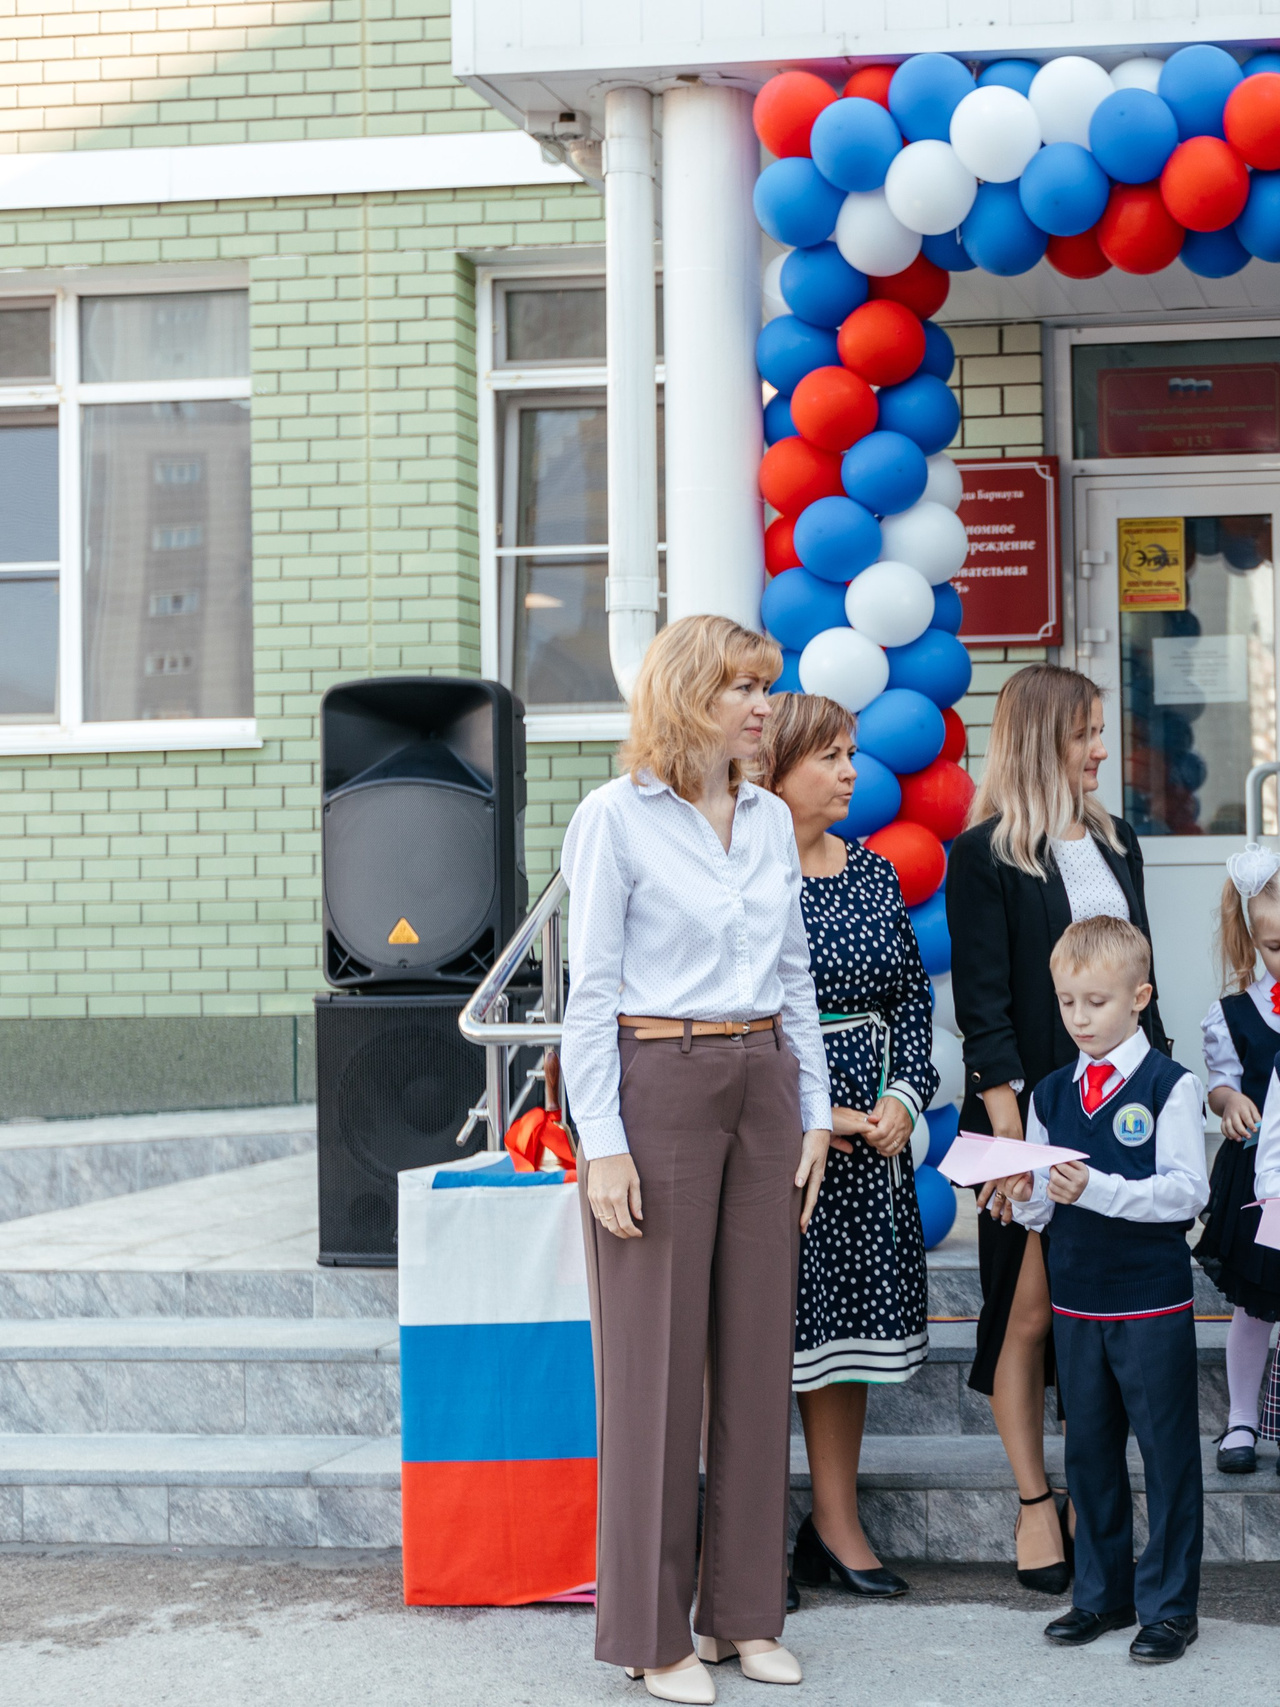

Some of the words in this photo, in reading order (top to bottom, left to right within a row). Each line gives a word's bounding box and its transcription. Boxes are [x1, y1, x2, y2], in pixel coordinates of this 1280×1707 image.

[976, 489, 1025, 502] Барнаула
[965, 524, 1016, 535] номное
[968, 540, 1036, 555] реждение
[954, 566, 1028, 578] овательная
